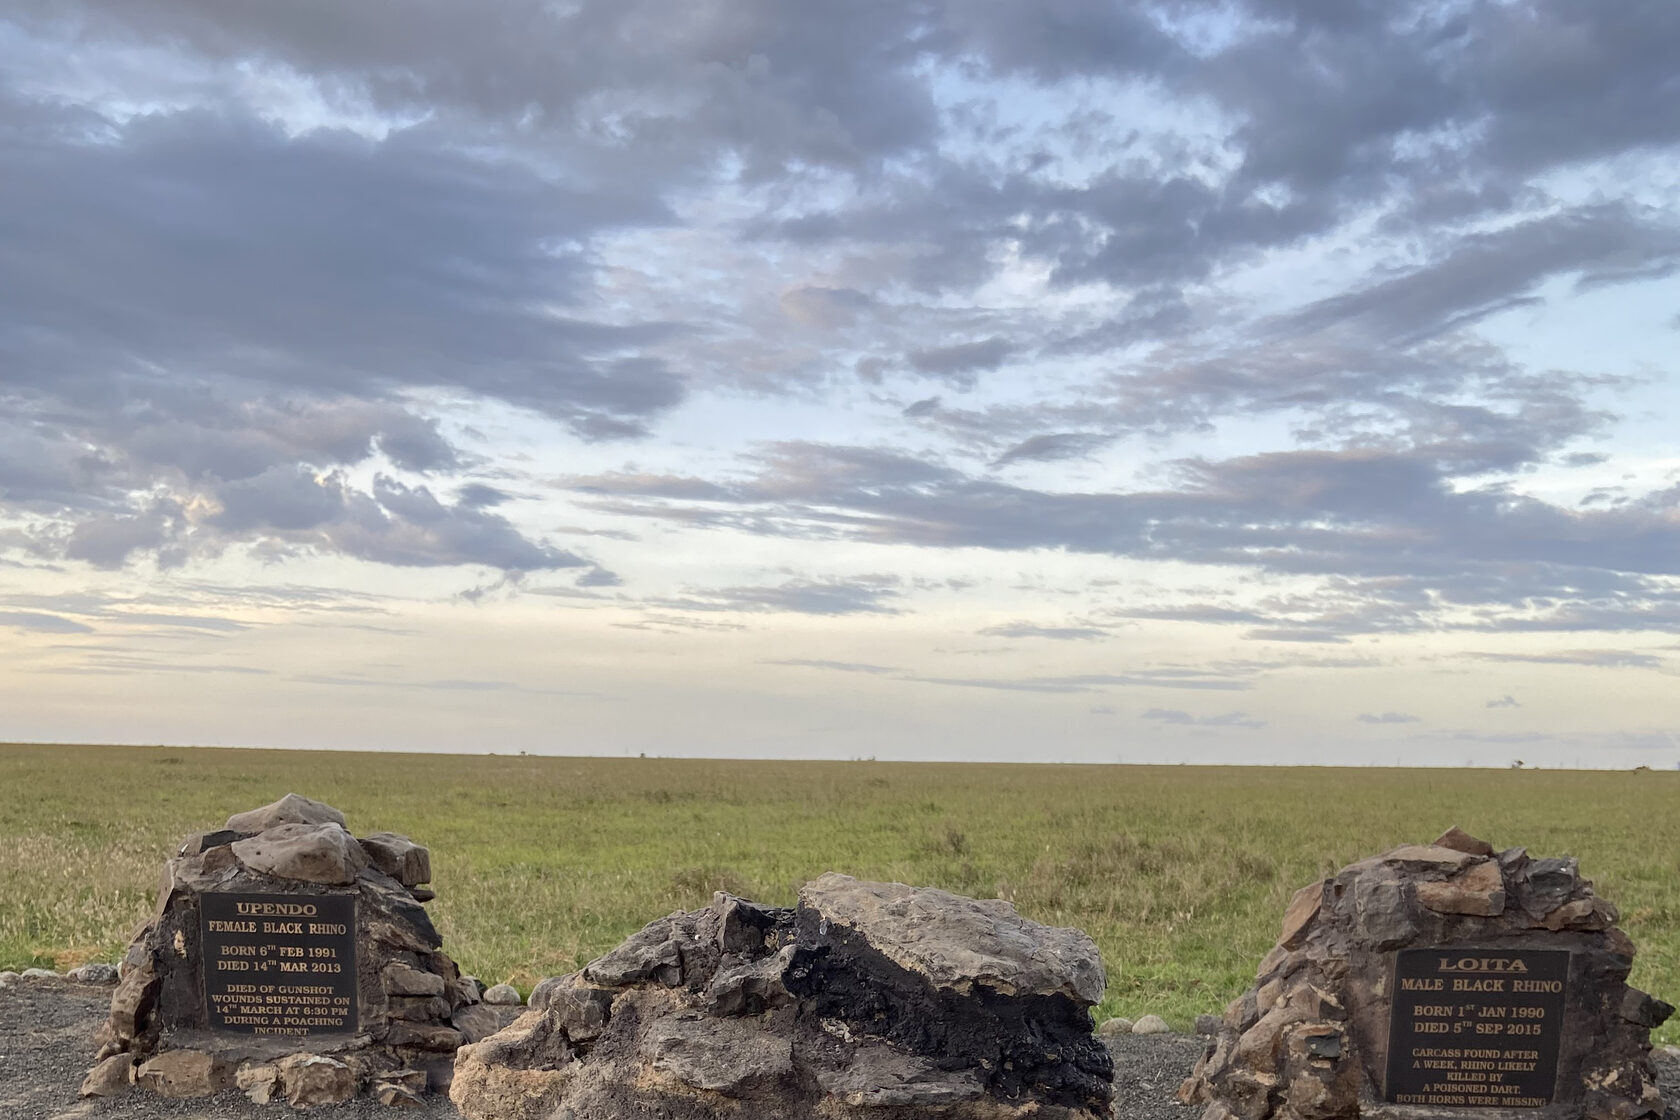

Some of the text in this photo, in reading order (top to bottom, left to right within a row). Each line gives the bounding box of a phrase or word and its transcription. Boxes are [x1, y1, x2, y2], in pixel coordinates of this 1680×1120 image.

[237, 903, 317, 915] UPENDO
[209, 921, 346, 935] FEMALE BLACK RHINO
[221, 946, 256, 956] BORN
[280, 947, 304, 957] FEB
[309, 948, 336, 958] 1991
[218, 961, 249, 971] DIED
[280, 963, 307, 972] MAR
[312, 963, 341, 973] 2013
[1438, 958, 1528, 971] LOITA
[279, 986, 334, 994] GUNSHOT
[1402, 979, 1562, 992] MALE BLACK RHINO
[212, 995, 262, 1003] WOUNDS
[266, 997, 330, 1005] SUSTAINED
[240, 1006, 282, 1014] MARCH
[304, 1007, 328, 1015] 6:30
[1414, 1005, 1453, 1016] BORN
[1478, 1007, 1506, 1018] JAN
[1512, 1008, 1544, 1018] 1990
[224, 1016, 343, 1026] DURING A POACHING
[255, 1027, 309, 1035] INCIDENT
[1414, 1023, 1448, 1032] DIED
[1476, 1023, 1503, 1034] SEP
[1507, 1024, 1541, 1035] 2015
[1412, 1048, 1538, 1059] CARCASS FOUND AFTER
[1461, 1062, 1494, 1070] RHINO
[1498, 1062, 1536, 1071] LIKELY
[1447, 1072, 1503, 1082] KILLED BY
[1423, 1083, 1430, 1092] A
[1434, 1084, 1488, 1093] POISONED
[1429, 1095, 1464, 1104] HORNS
[1468, 1096, 1498, 1105] WERE
